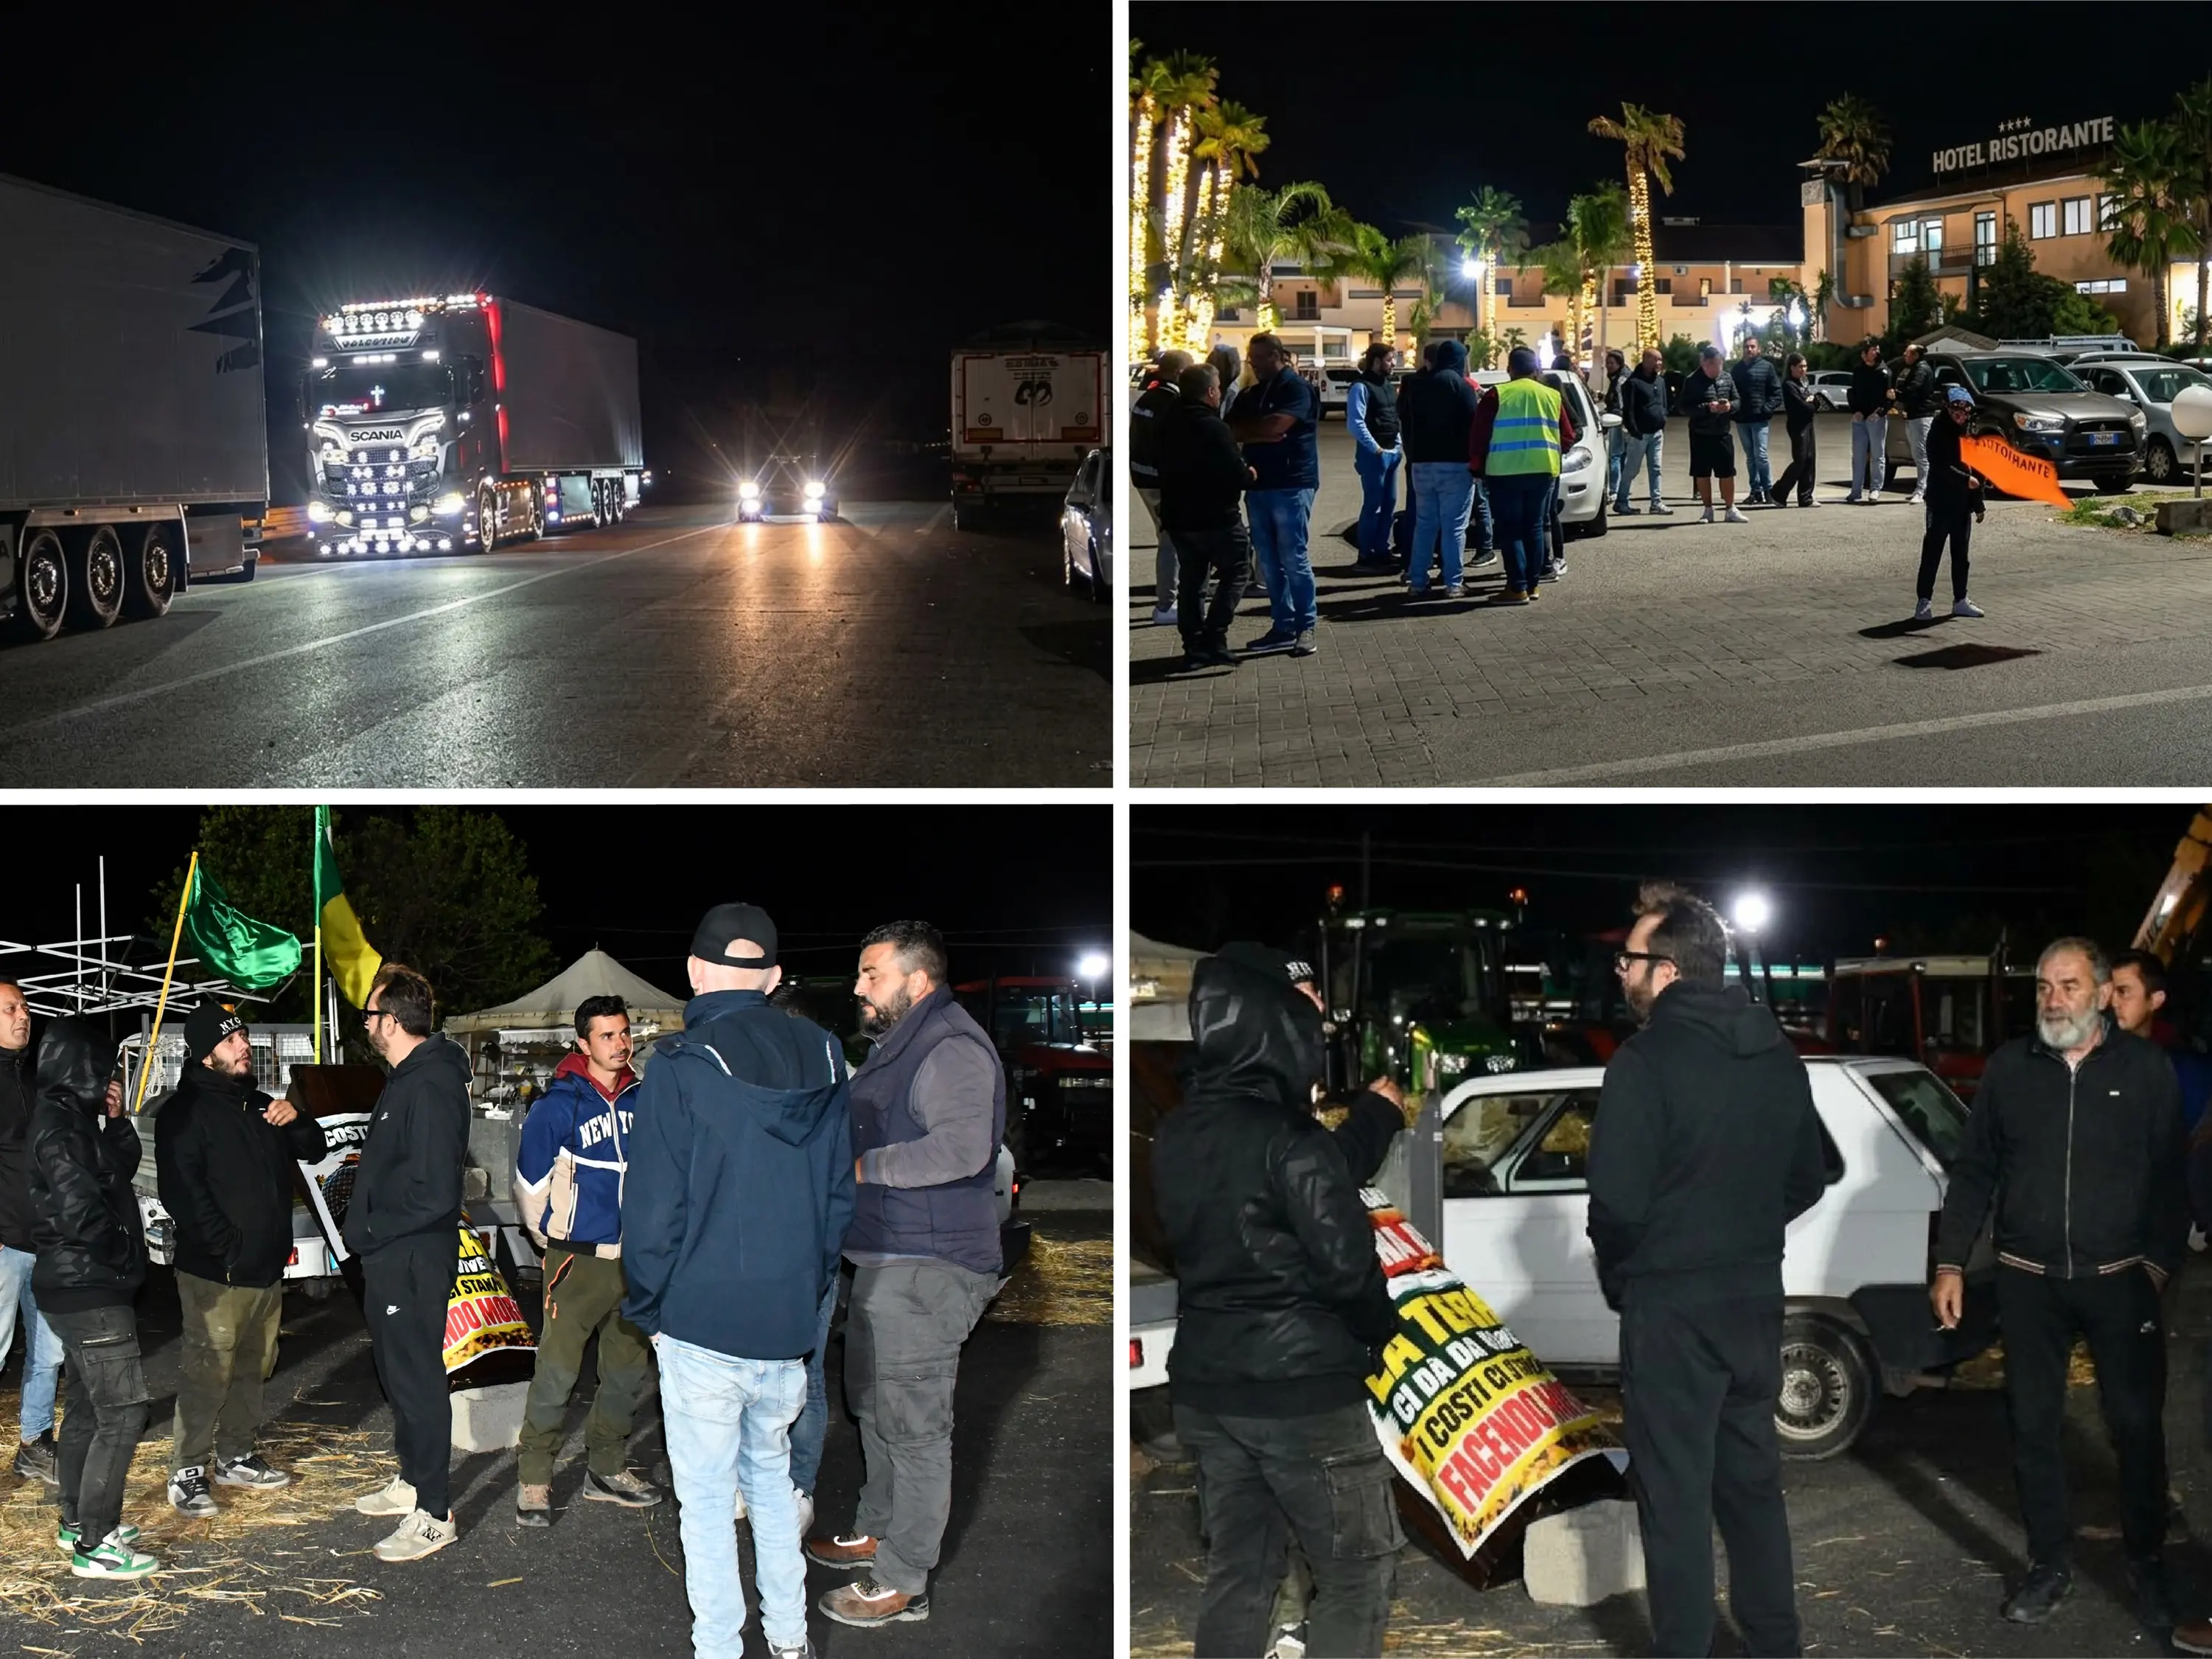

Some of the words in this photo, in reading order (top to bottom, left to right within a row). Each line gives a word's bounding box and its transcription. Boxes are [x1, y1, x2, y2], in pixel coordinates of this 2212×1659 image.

[1933, 143, 1986, 172] HOTEL
[1989, 116, 2114, 162] RISTORANTE
[350, 430, 404, 441] SCANIA
[579, 1111, 614, 1149] NEW
[1364, 1333, 1426, 1405] LA
[1392, 1383, 1424, 1424] CI
[1445, 1336, 1489, 1370] DA
[1483, 1364, 1513, 1391] CI
[1425, 1377, 1493, 1448] COSTI
[1417, 1436, 1435, 1462] I
[1438, 1388, 1557, 1515] FACENDO
